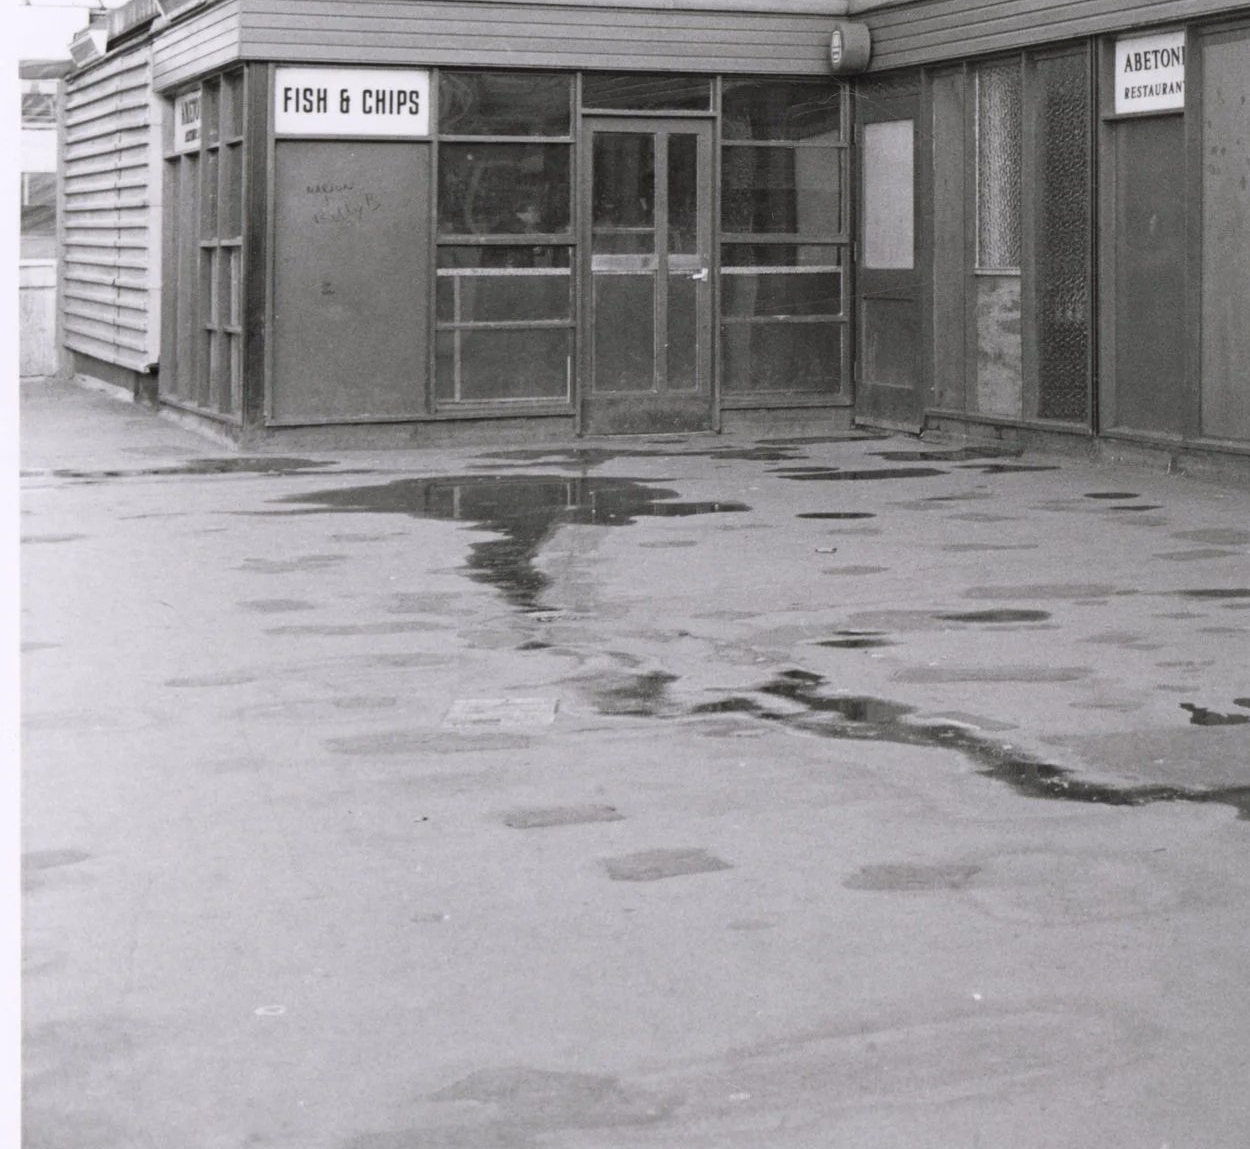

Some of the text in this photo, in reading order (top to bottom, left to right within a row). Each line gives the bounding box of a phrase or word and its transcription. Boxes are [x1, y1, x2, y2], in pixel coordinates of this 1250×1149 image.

[283, 86, 420, 116] FISH & CHIPS
[1124, 80, 1185, 100] RESTAURAN
